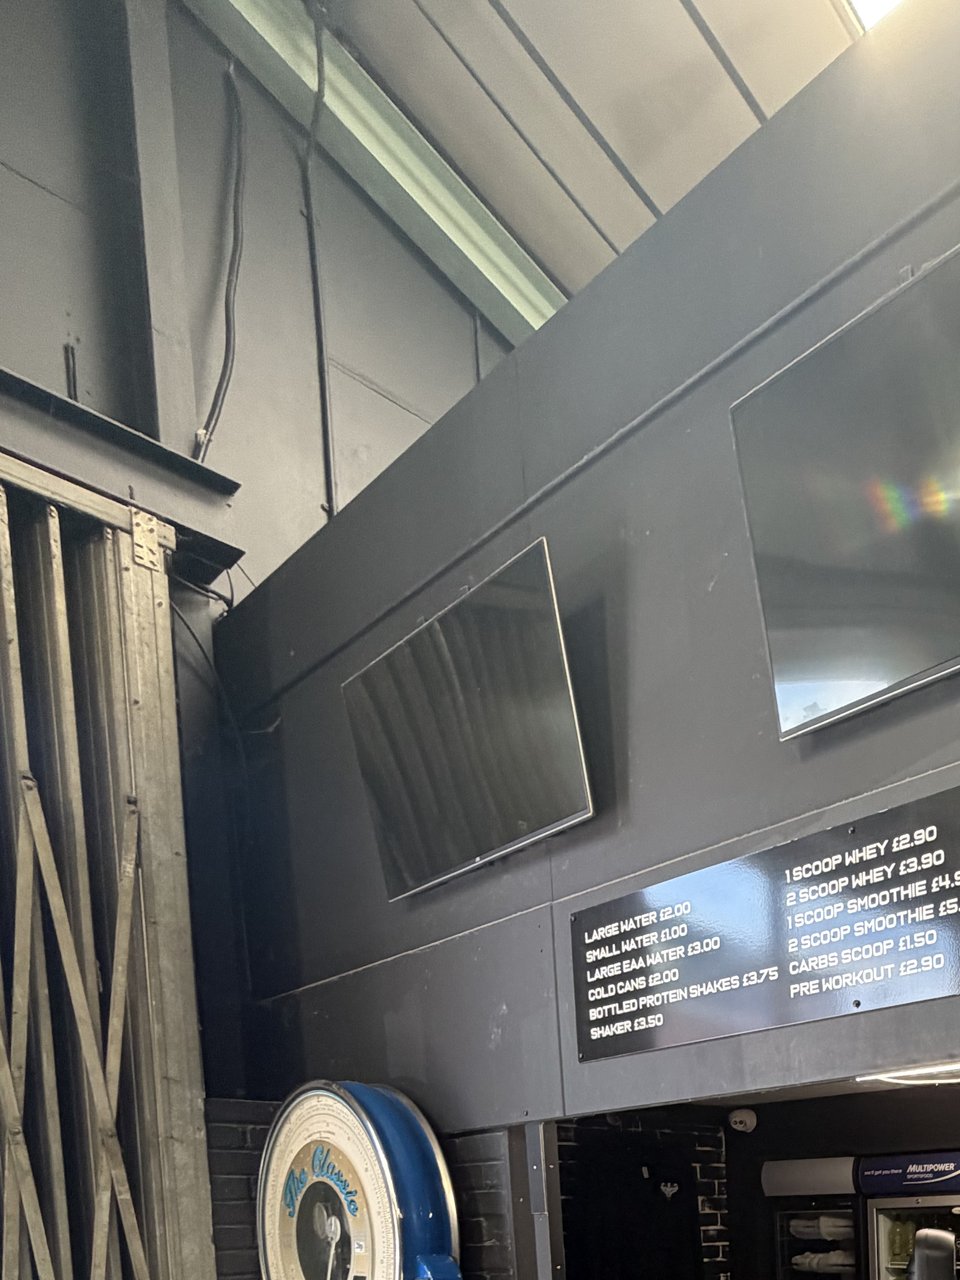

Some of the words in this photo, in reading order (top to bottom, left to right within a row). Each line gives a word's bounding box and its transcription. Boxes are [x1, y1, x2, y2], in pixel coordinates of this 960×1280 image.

[785, 869, 791, 883] 1
[792, 854, 843, 881] SCOOP
[844, 840, 889, 867] WHEY
[891, 825, 938, 852] £2.90
[786, 892, 797, 907] 2
[799, 877, 849, 903] SCOOP
[851, 862, 896, 888] WHEY
[899, 850, 945, 876] £3.90
[584, 923, 619, 943] LARGE
[620, 911, 657, 932] WATER
[659, 901, 691, 922] £2.00
[787, 915, 793, 929] 1
[794, 902, 844, 927] SCOOP
[847, 880, 927, 914] SMOOTHIE
[586, 944, 620, 963] SMALL
[621, 932, 658, 952] WATER
[660, 923, 688, 942] £1.00
[788, 938, 798, 952] 2
[801, 924, 851, 950] SCOOP
[853, 904, 935, 936] SMOOTHIE
[587, 963, 621, 982] LARGE
[623, 956, 645, 973] EAA
[646, 947, 685, 967] WATER
[687, 936, 720, 956] £3.00
[789, 952, 839, 975] CARBS
[841, 939, 894, 964] SCOOP
[898, 929, 938, 951] £1.50
[588, 984, 615, 1002] COLD
[617, 976, 646, 995] CANS
[648, 968, 679, 987] £2.00
[589, 998, 638, 1021] BOTTLED
[639, 989, 688, 1010] PROTEIN
[689, 975, 740, 1000] SHAKES
[742, 967, 779, 988] £3.75
[790, 978, 820, 998] PRE
[822, 964, 895, 992] WORKOUT
[899, 953, 945, 976] £2.90
[590, 1019, 632, 1040] SHAKER
[633, 1013, 664, 1032] £3.50
[906, 1162, 955, 1173] MULTIPOWER
